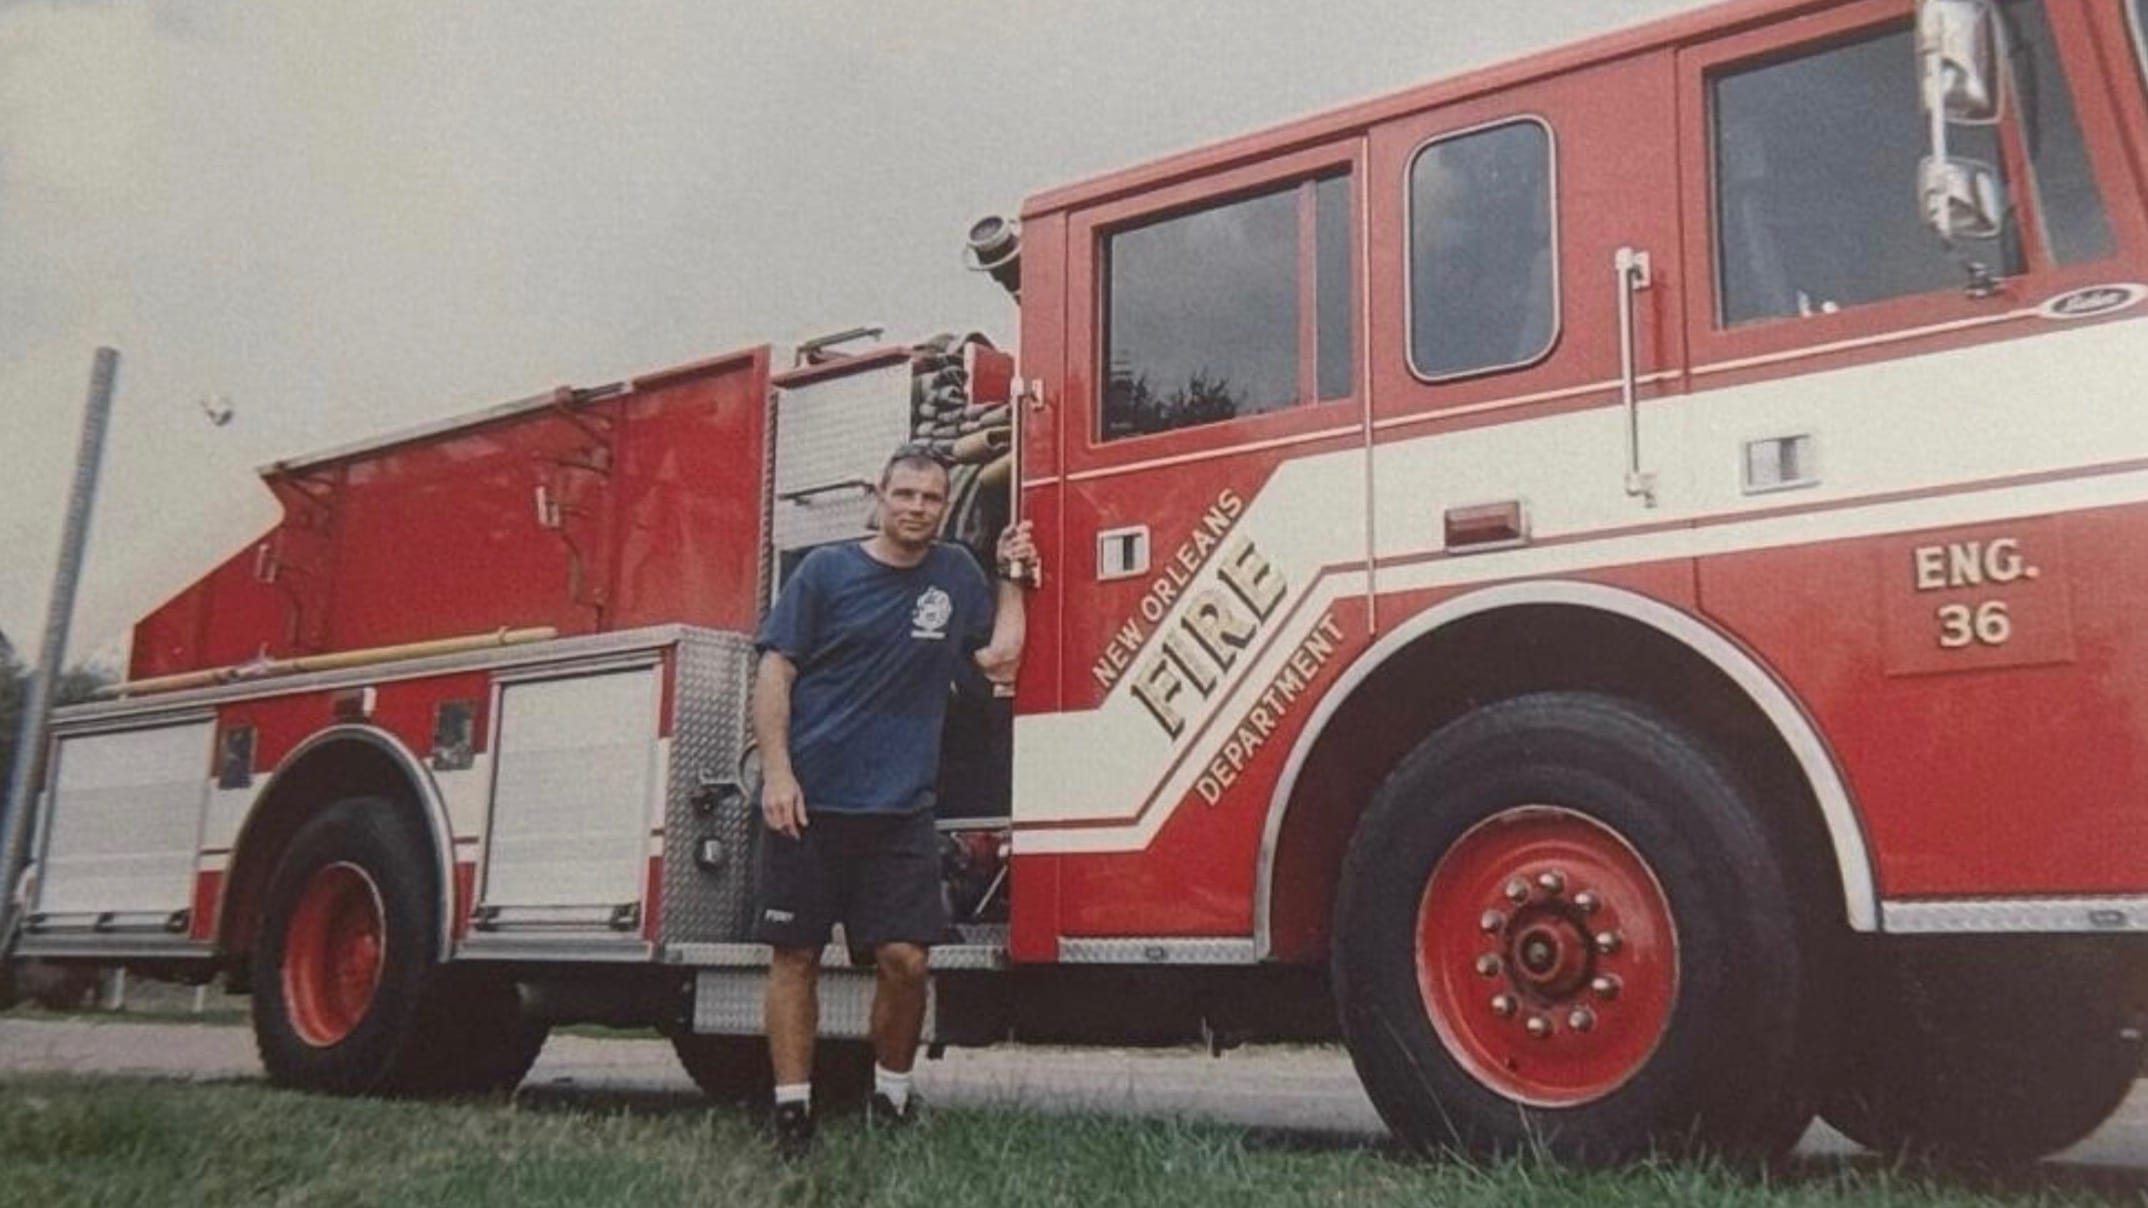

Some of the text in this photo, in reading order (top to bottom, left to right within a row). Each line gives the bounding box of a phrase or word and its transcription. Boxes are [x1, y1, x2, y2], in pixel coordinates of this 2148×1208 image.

[1092, 488, 1243, 688] NEW ORLEANS
[1130, 535, 1288, 741] FIRE
[1914, 538, 2040, 590] ENG.
[1937, 600, 2010, 648] 36
[1195, 613, 1345, 806] DEPARTMENT
